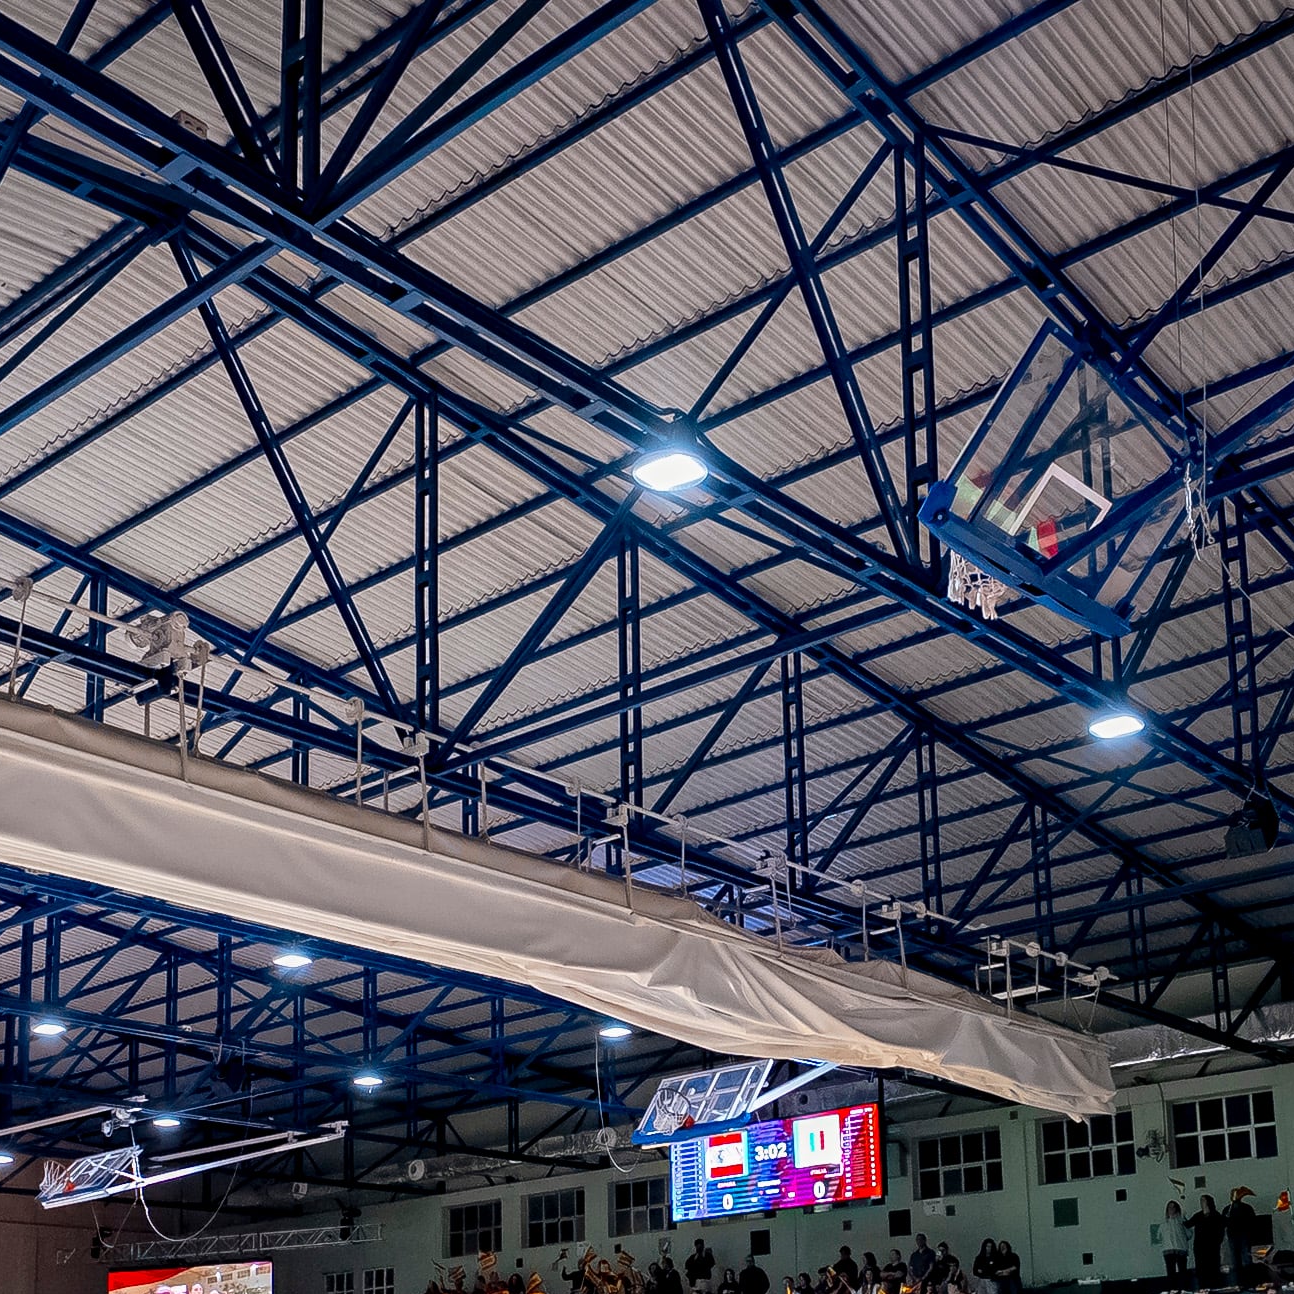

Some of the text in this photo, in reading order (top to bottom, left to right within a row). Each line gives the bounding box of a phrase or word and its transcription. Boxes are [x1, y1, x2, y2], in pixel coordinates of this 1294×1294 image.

[754, 1142, 787, 1161] 3:02
[813, 1181, 826, 1198] 0
[722, 1193, 734, 1210] 0
